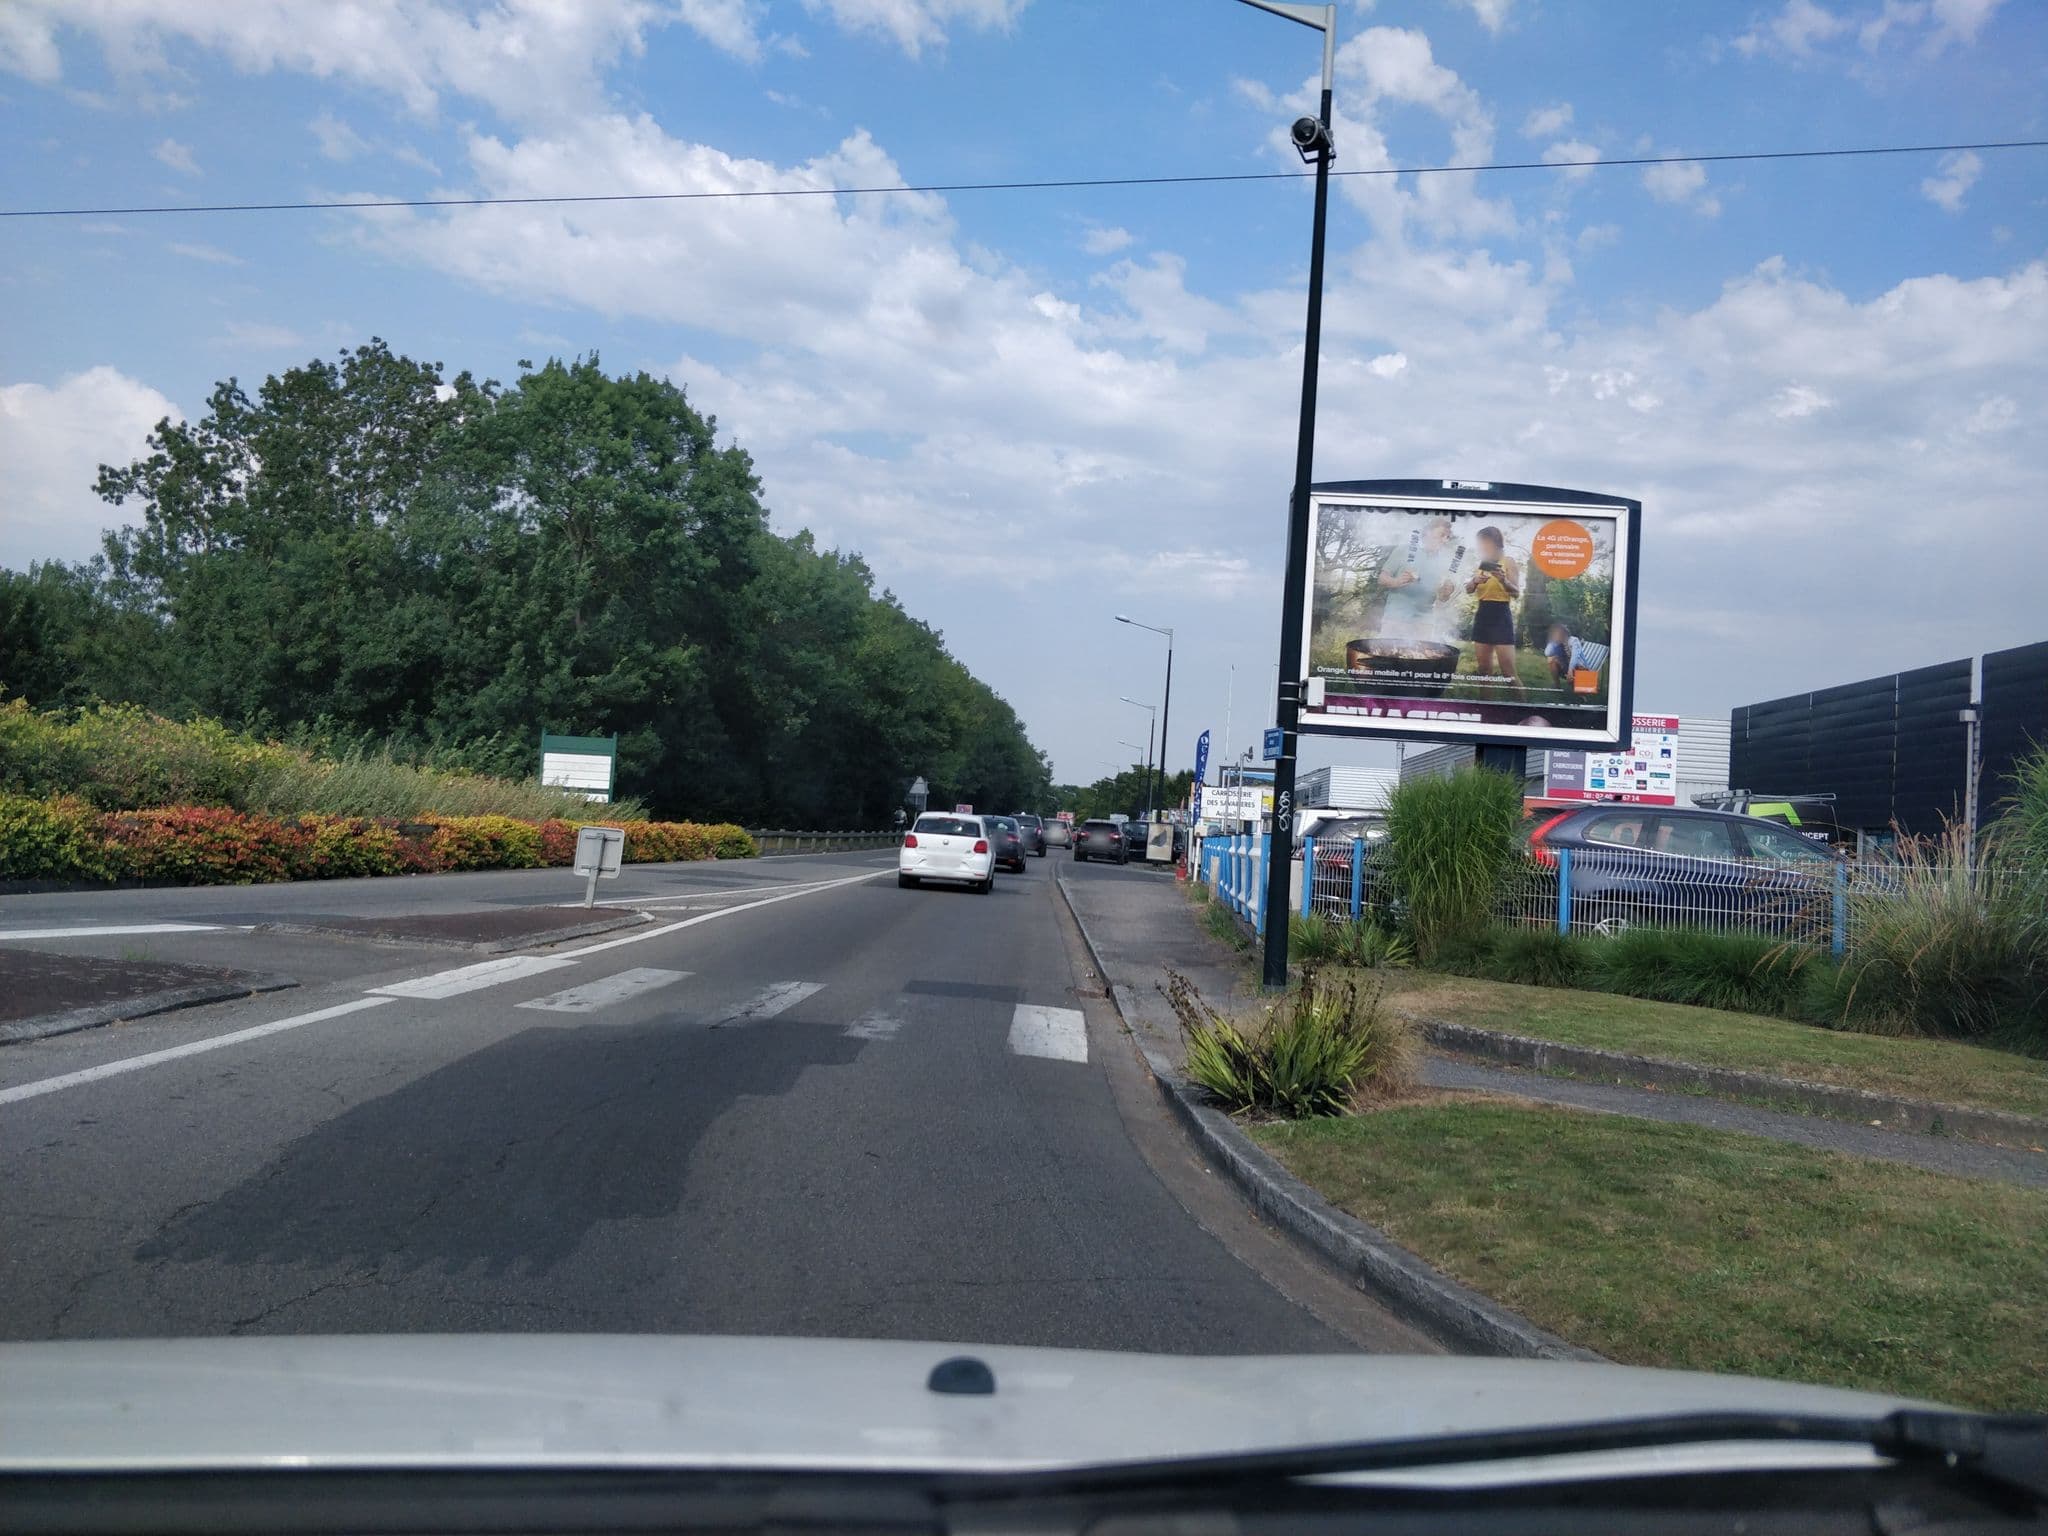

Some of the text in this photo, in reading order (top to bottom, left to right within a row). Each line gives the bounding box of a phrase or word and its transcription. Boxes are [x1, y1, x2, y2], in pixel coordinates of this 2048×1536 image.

[1317, 665, 1347, 675] Orange,
[1347, 668, 1373, 676] réseau
[1374, 669, 1400, 677] mobile
[1414, 671, 1432, 679] pour
[1211, 789, 1253, 798] CARROSSRIE
